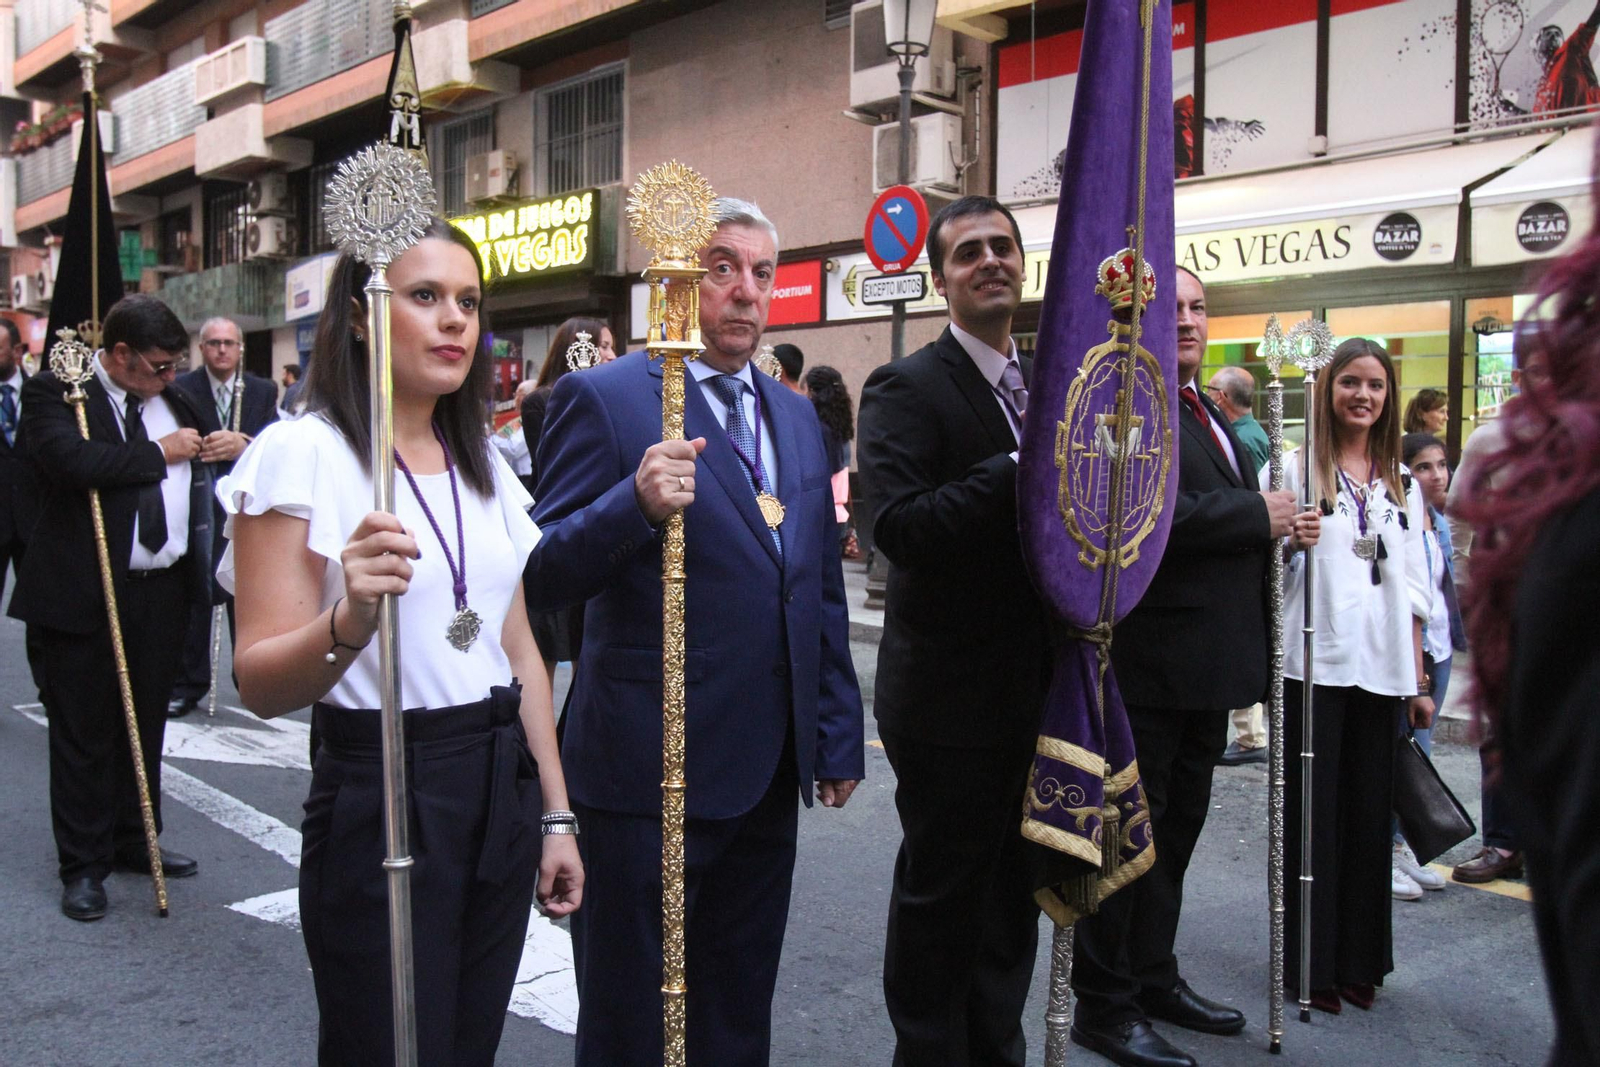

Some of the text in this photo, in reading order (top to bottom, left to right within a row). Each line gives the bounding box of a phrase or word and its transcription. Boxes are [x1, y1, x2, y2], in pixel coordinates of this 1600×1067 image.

[517, 192, 592, 235] JUEGOS
[1374, 230, 1419, 243] BAZAR
[1518, 220, 1567, 236] BAZAR
[494, 224, 588, 276] VEGAS
[1182, 225, 1351, 272] AS VEGAS
[882, 263, 902, 272] GRUA
[771, 285, 813, 300] PORTIUM
[864, 281, 896, 298] EXCEPTO
[896, 278, 921, 296] MOTOS
